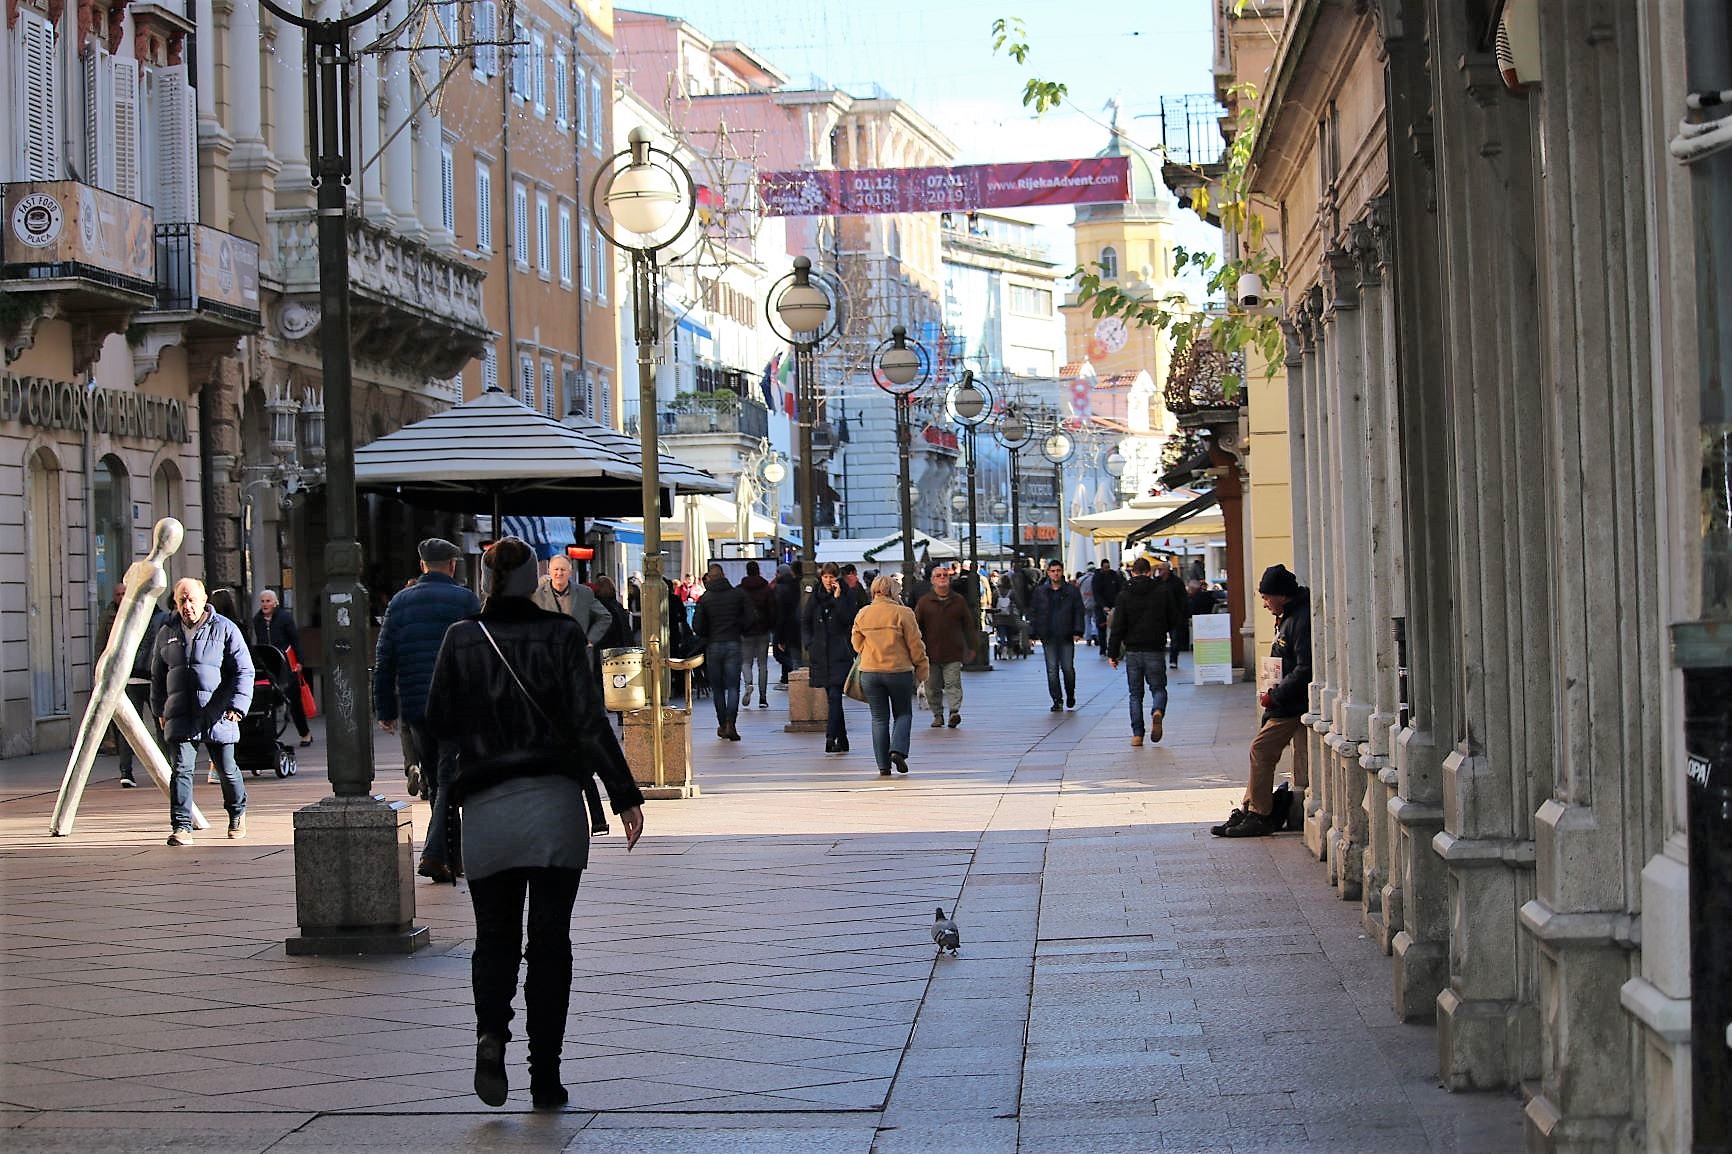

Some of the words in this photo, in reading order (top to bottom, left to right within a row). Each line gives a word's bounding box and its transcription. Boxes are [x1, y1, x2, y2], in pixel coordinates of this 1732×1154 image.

[986, 174, 1119, 191] www.RijekaAdvent.com
[18, 197, 35, 214] FAST
[38, 196, 58, 212] FOOD
[27, 233, 52, 243] PLACA
[28, 376, 91, 433] COLORS
[94, 386, 113, 433] OF
